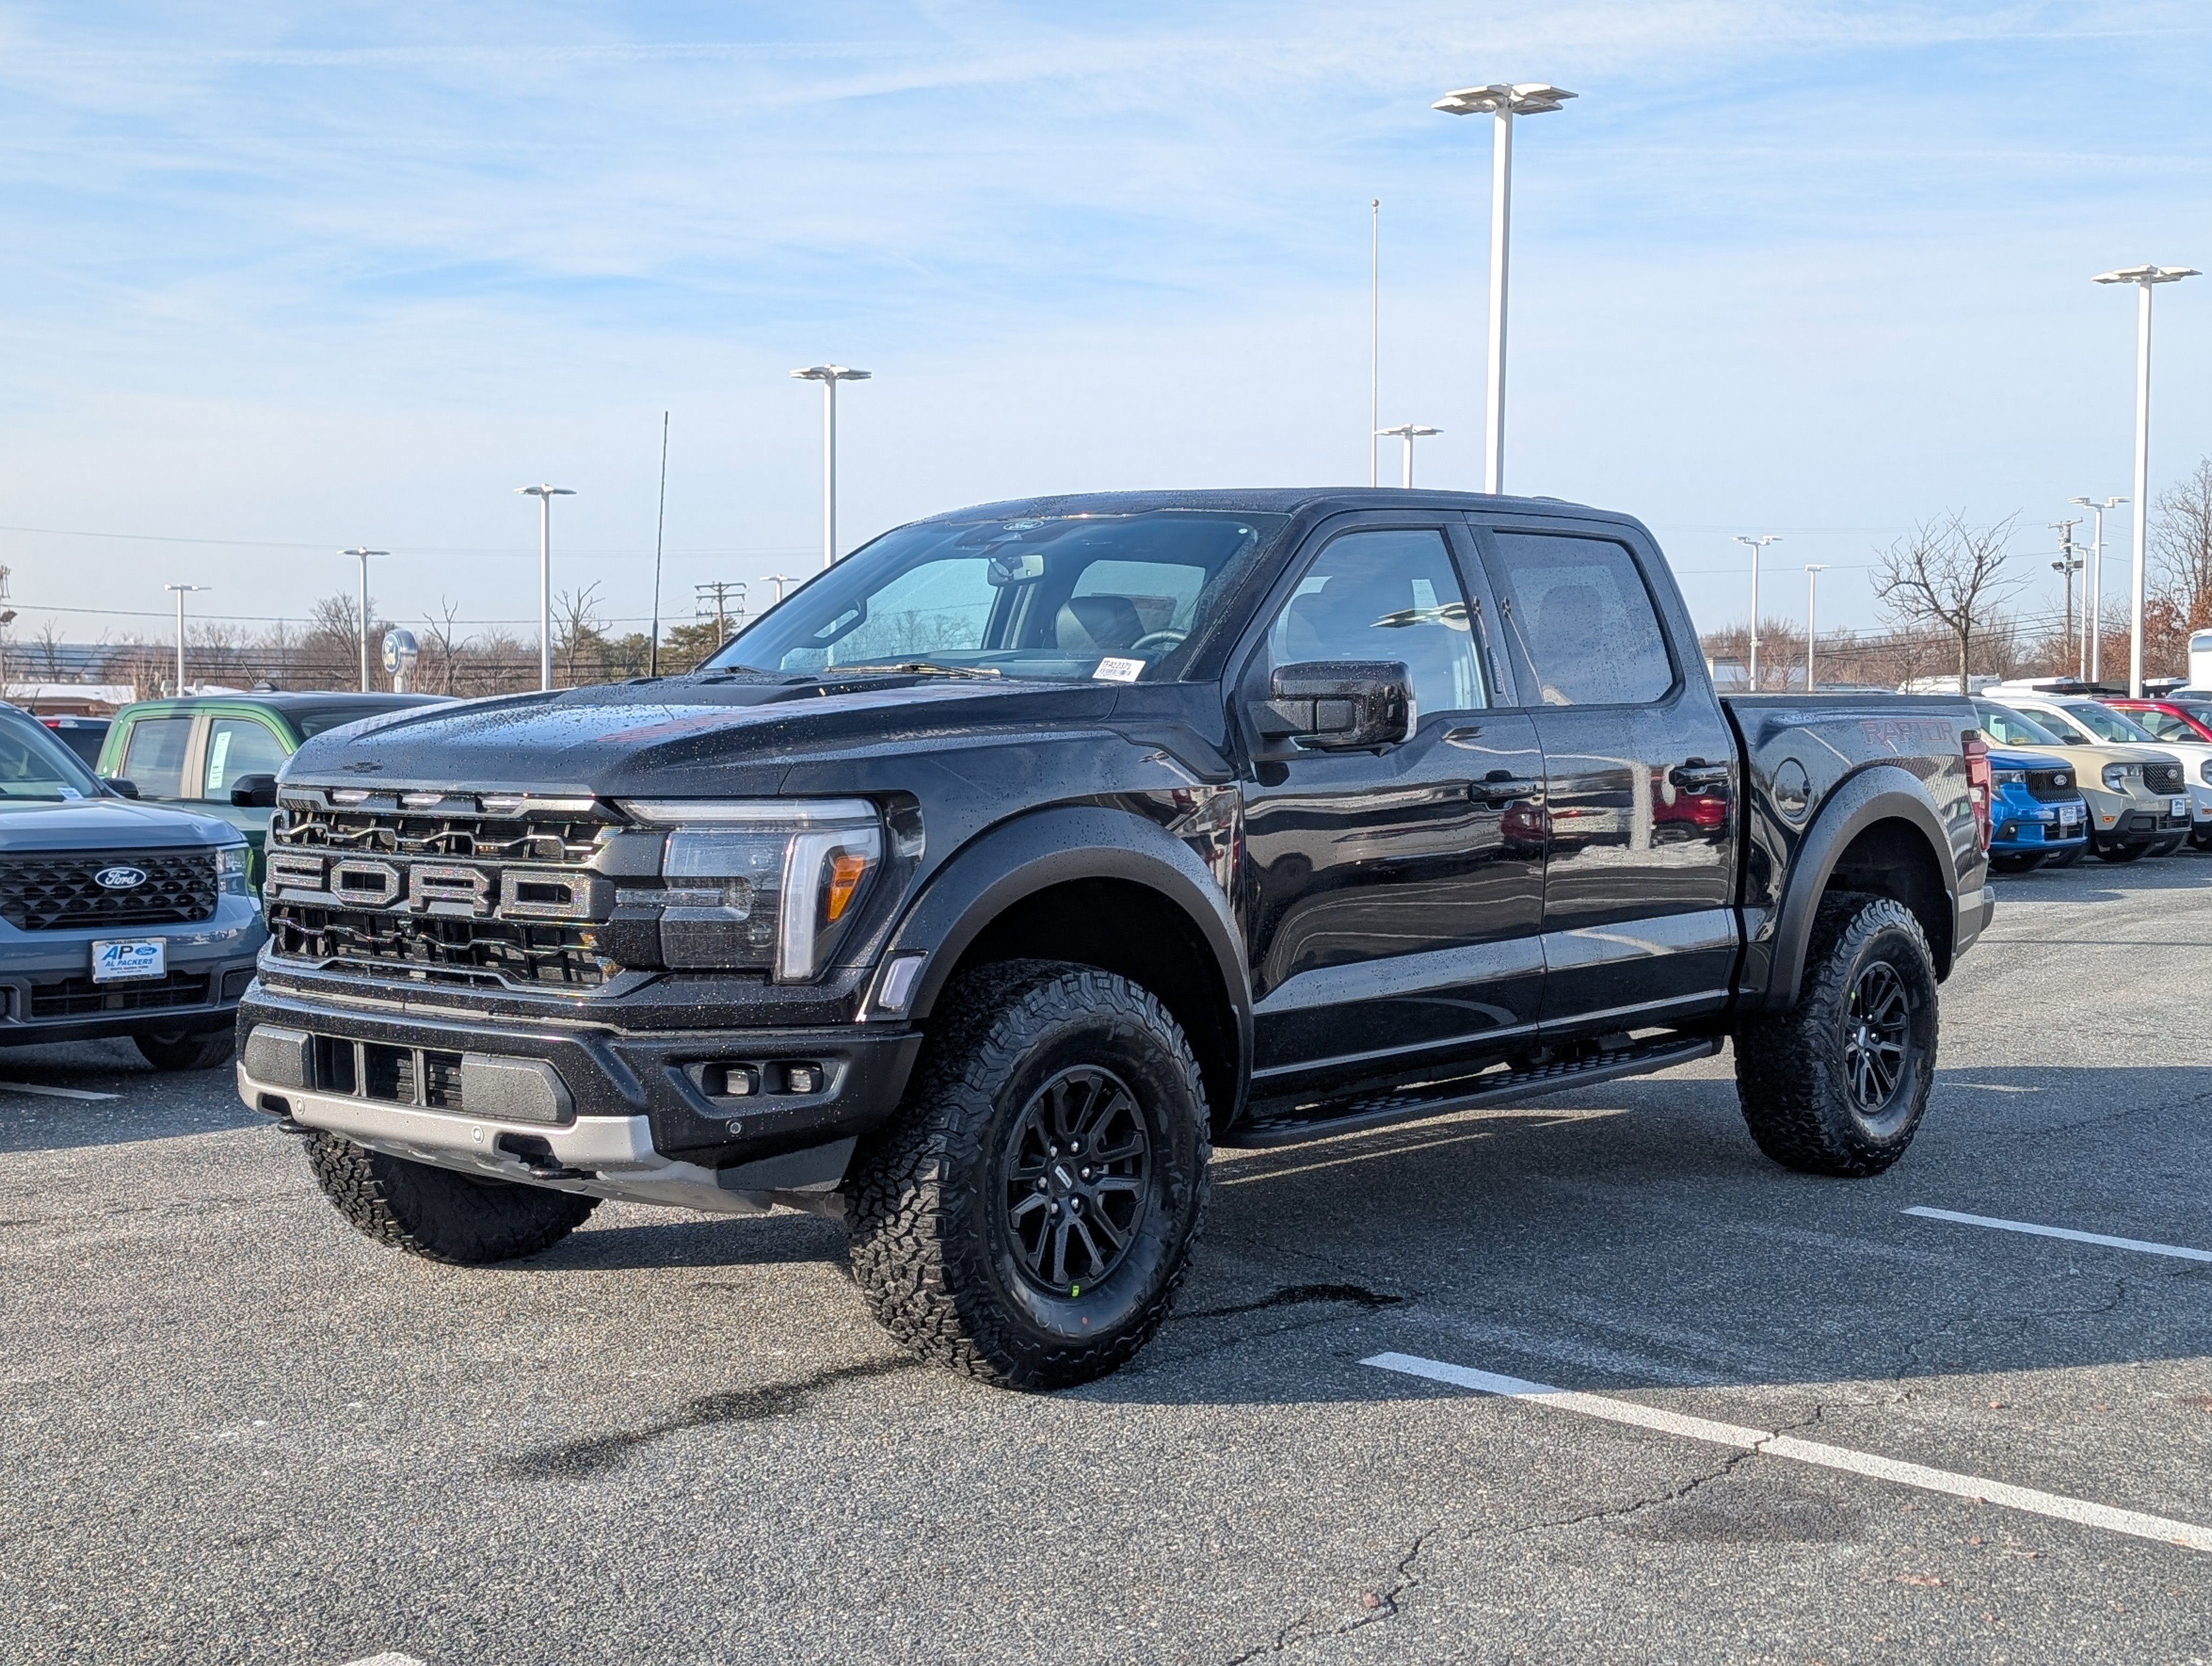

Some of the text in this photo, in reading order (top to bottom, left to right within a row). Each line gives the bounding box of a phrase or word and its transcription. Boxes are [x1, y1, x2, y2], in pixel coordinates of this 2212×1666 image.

[1859, 720, 1959, 752] RAPTOR
[105, 870, 137, 885] Ford
[266, 853, 592, 919] FORD
[101, 945, 134, 960] AP
